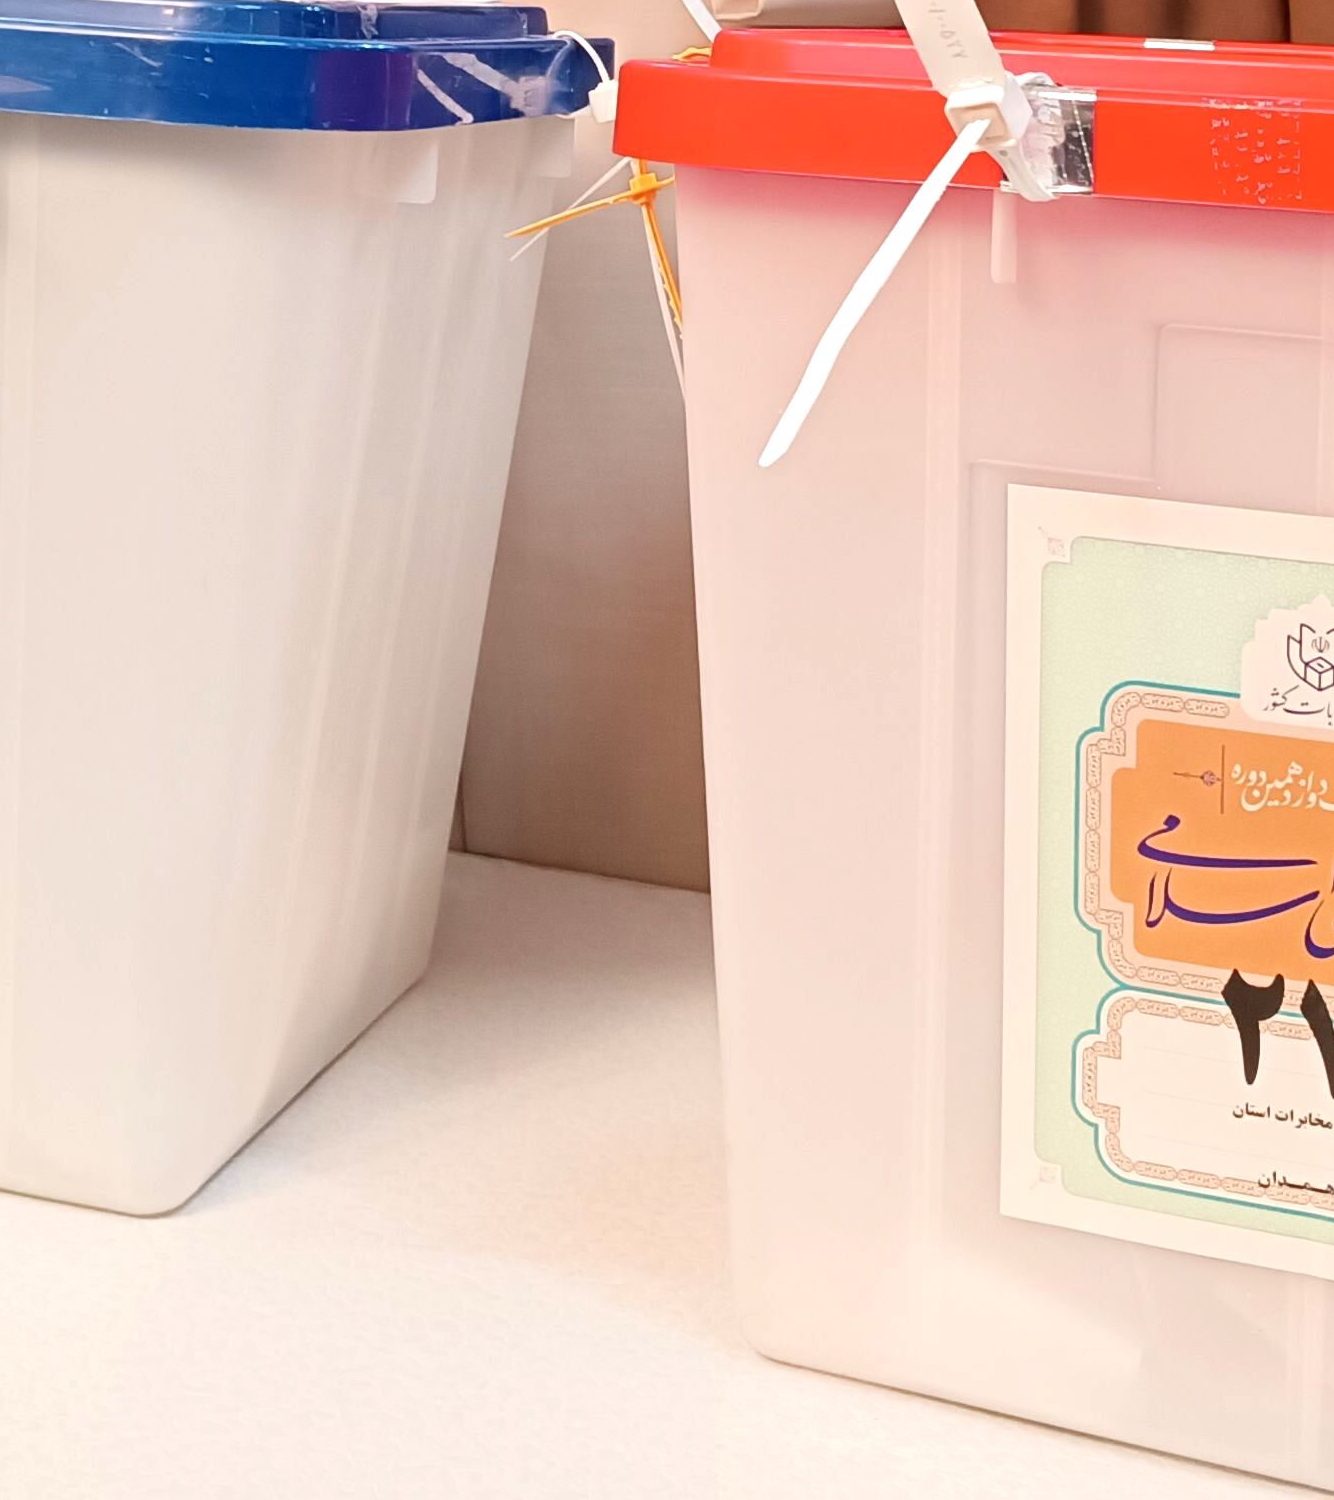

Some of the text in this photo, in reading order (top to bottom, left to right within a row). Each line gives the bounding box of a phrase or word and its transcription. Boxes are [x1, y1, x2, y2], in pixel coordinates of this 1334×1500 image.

[1263, 685, 1299, 711] کشور
[1231, 763, 1267, 787] دوره
[1241, 761, 1328, 812] دوازدهمین
[1232, 1103, 1271, 1118] استان
[1275, 1110, 1333, 1130] مخابرات
